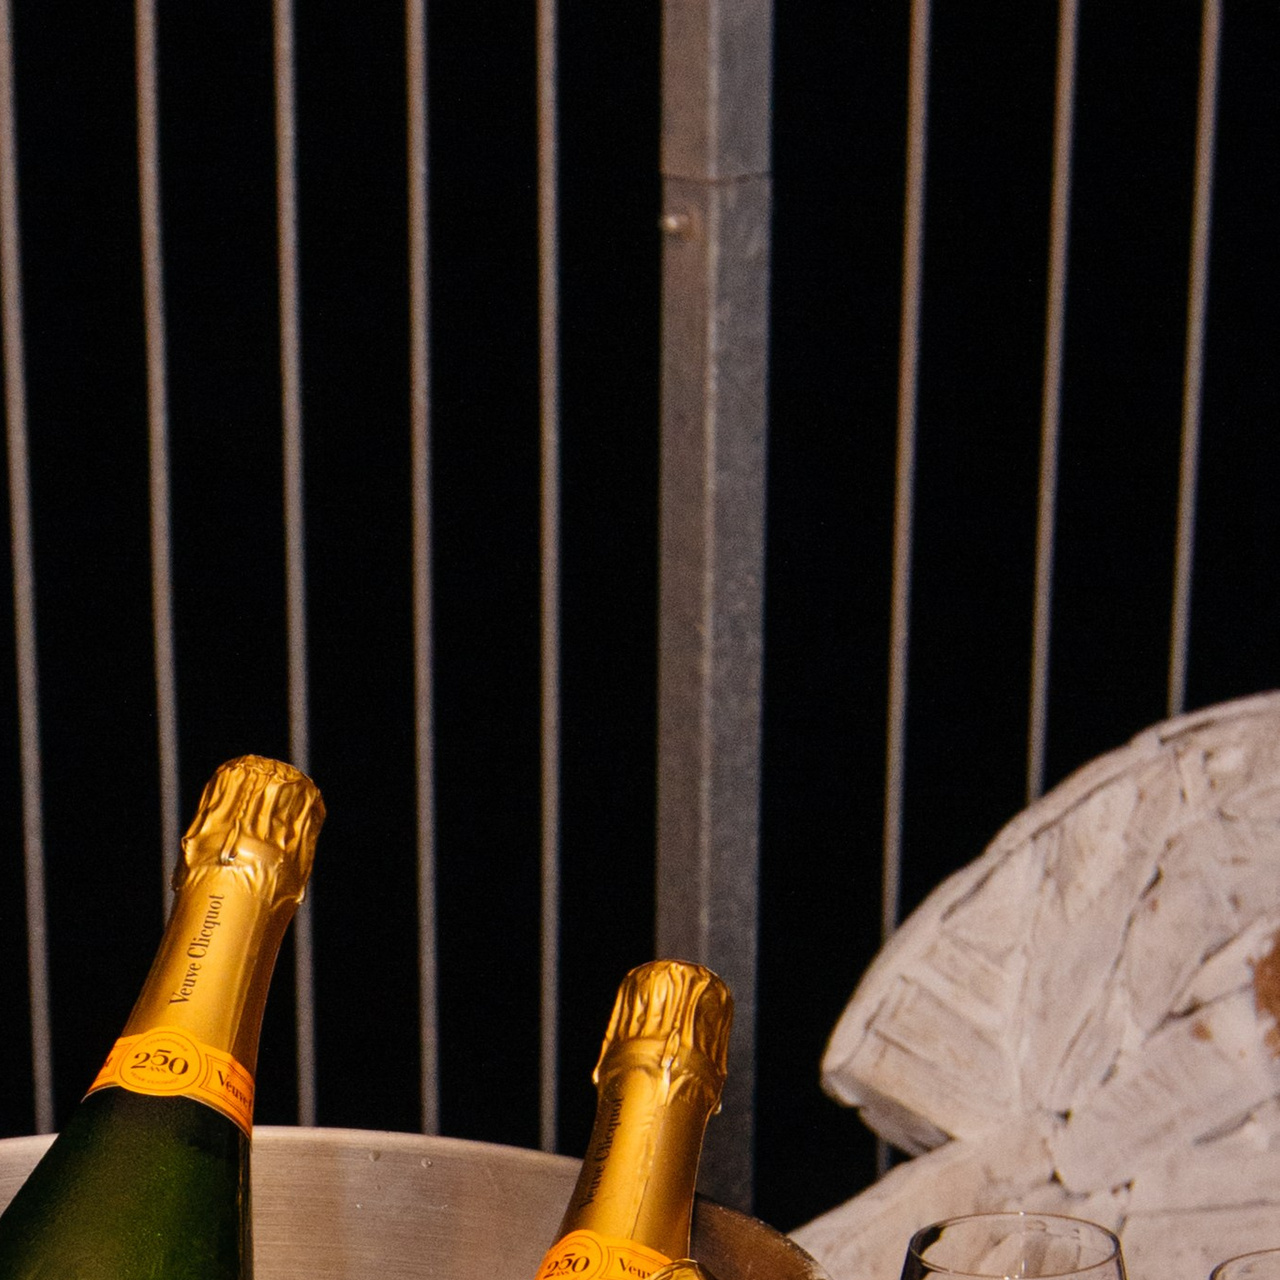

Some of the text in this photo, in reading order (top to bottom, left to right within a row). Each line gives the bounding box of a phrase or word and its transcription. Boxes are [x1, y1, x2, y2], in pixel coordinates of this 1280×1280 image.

[168, 894, 224, 1005] Veuve Clicquot
[130, 1048, 189, 1076] 250
[578, 1097, 625, 1211] Veuve Clicquot
[543, 1253, 590, 1279] 250
